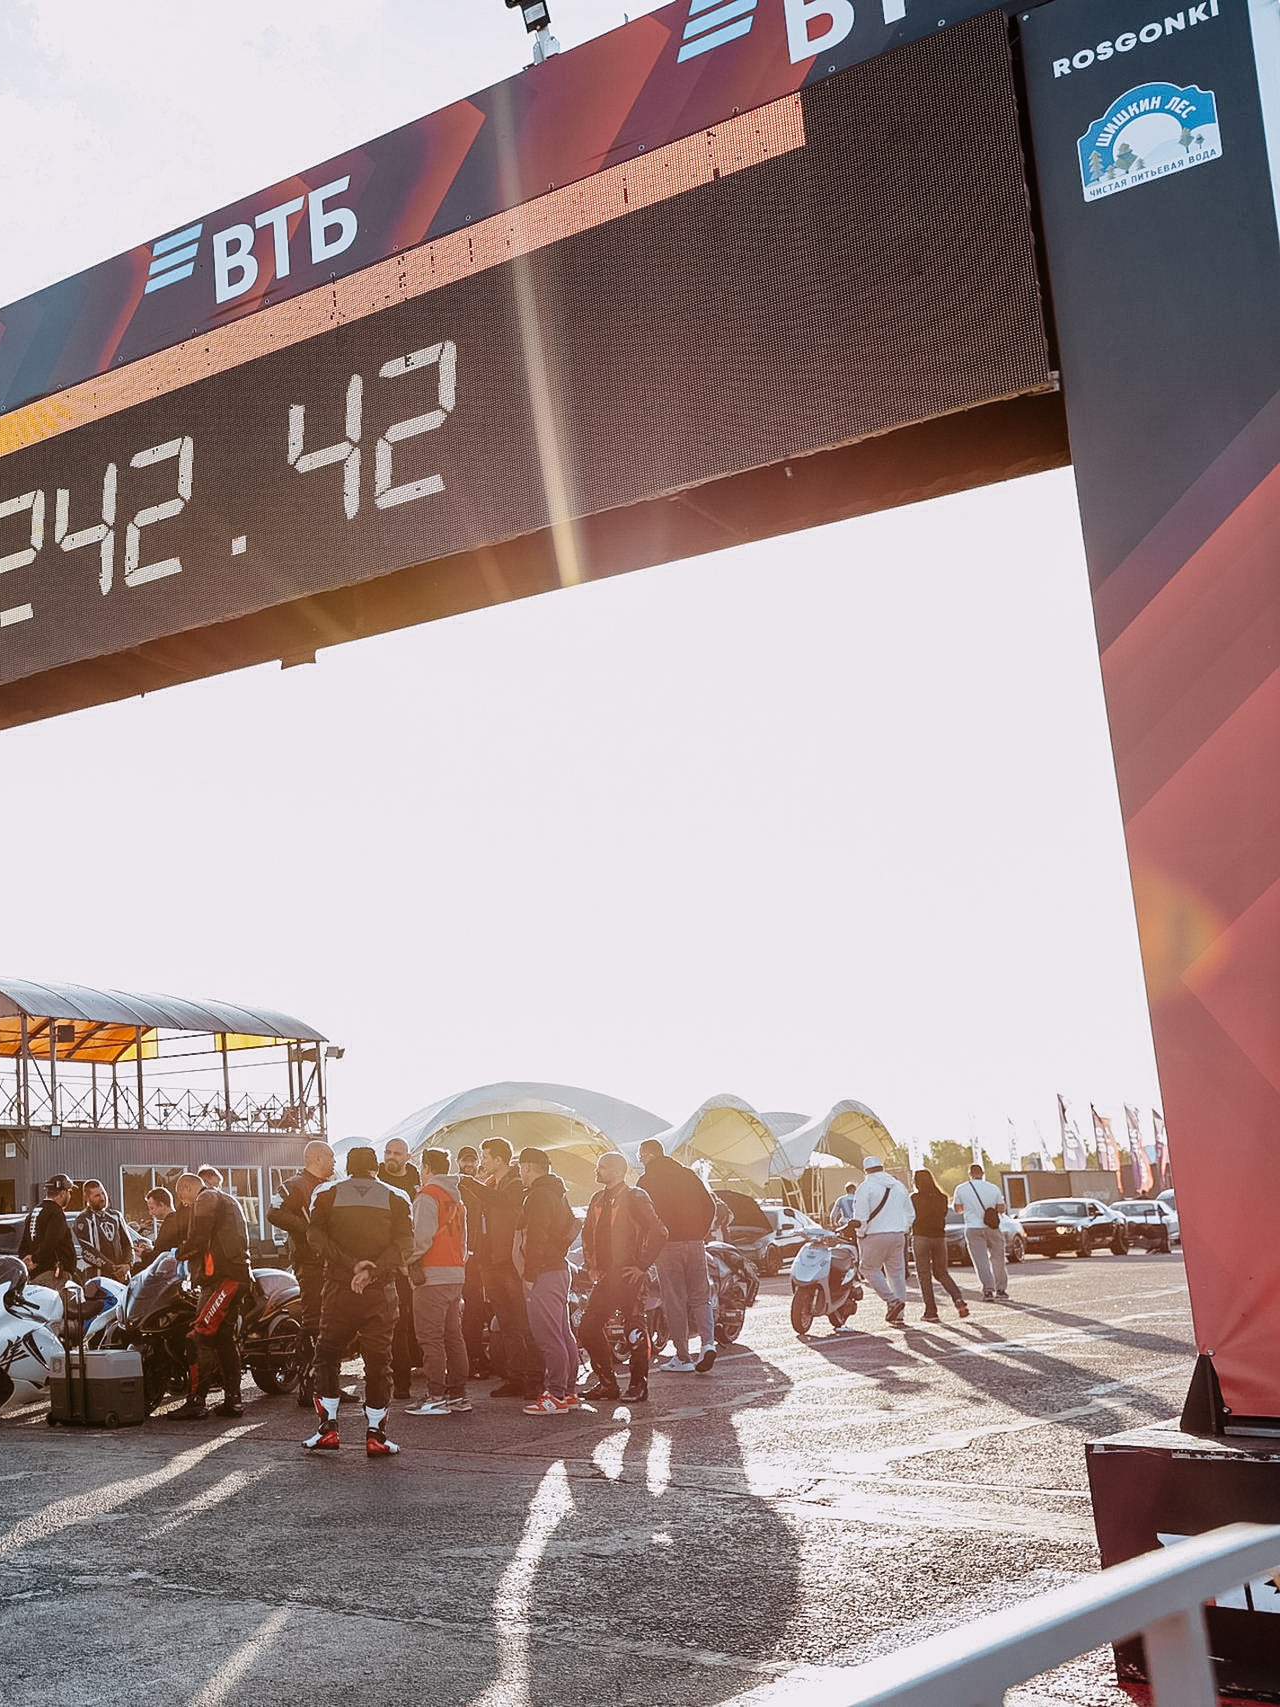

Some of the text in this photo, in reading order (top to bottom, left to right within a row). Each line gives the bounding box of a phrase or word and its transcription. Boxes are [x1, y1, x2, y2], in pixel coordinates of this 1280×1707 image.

[1052, 0, 1220, 79] ROSGONKI
[1095, 95, 1197, 148] ШИШКИН ЛЕС
[1089, 148, 1217, 198] ЧИСТАЯ ПИТЬЕВАЯ ВОДА
[211, 174, 359, 305] ВТБ
